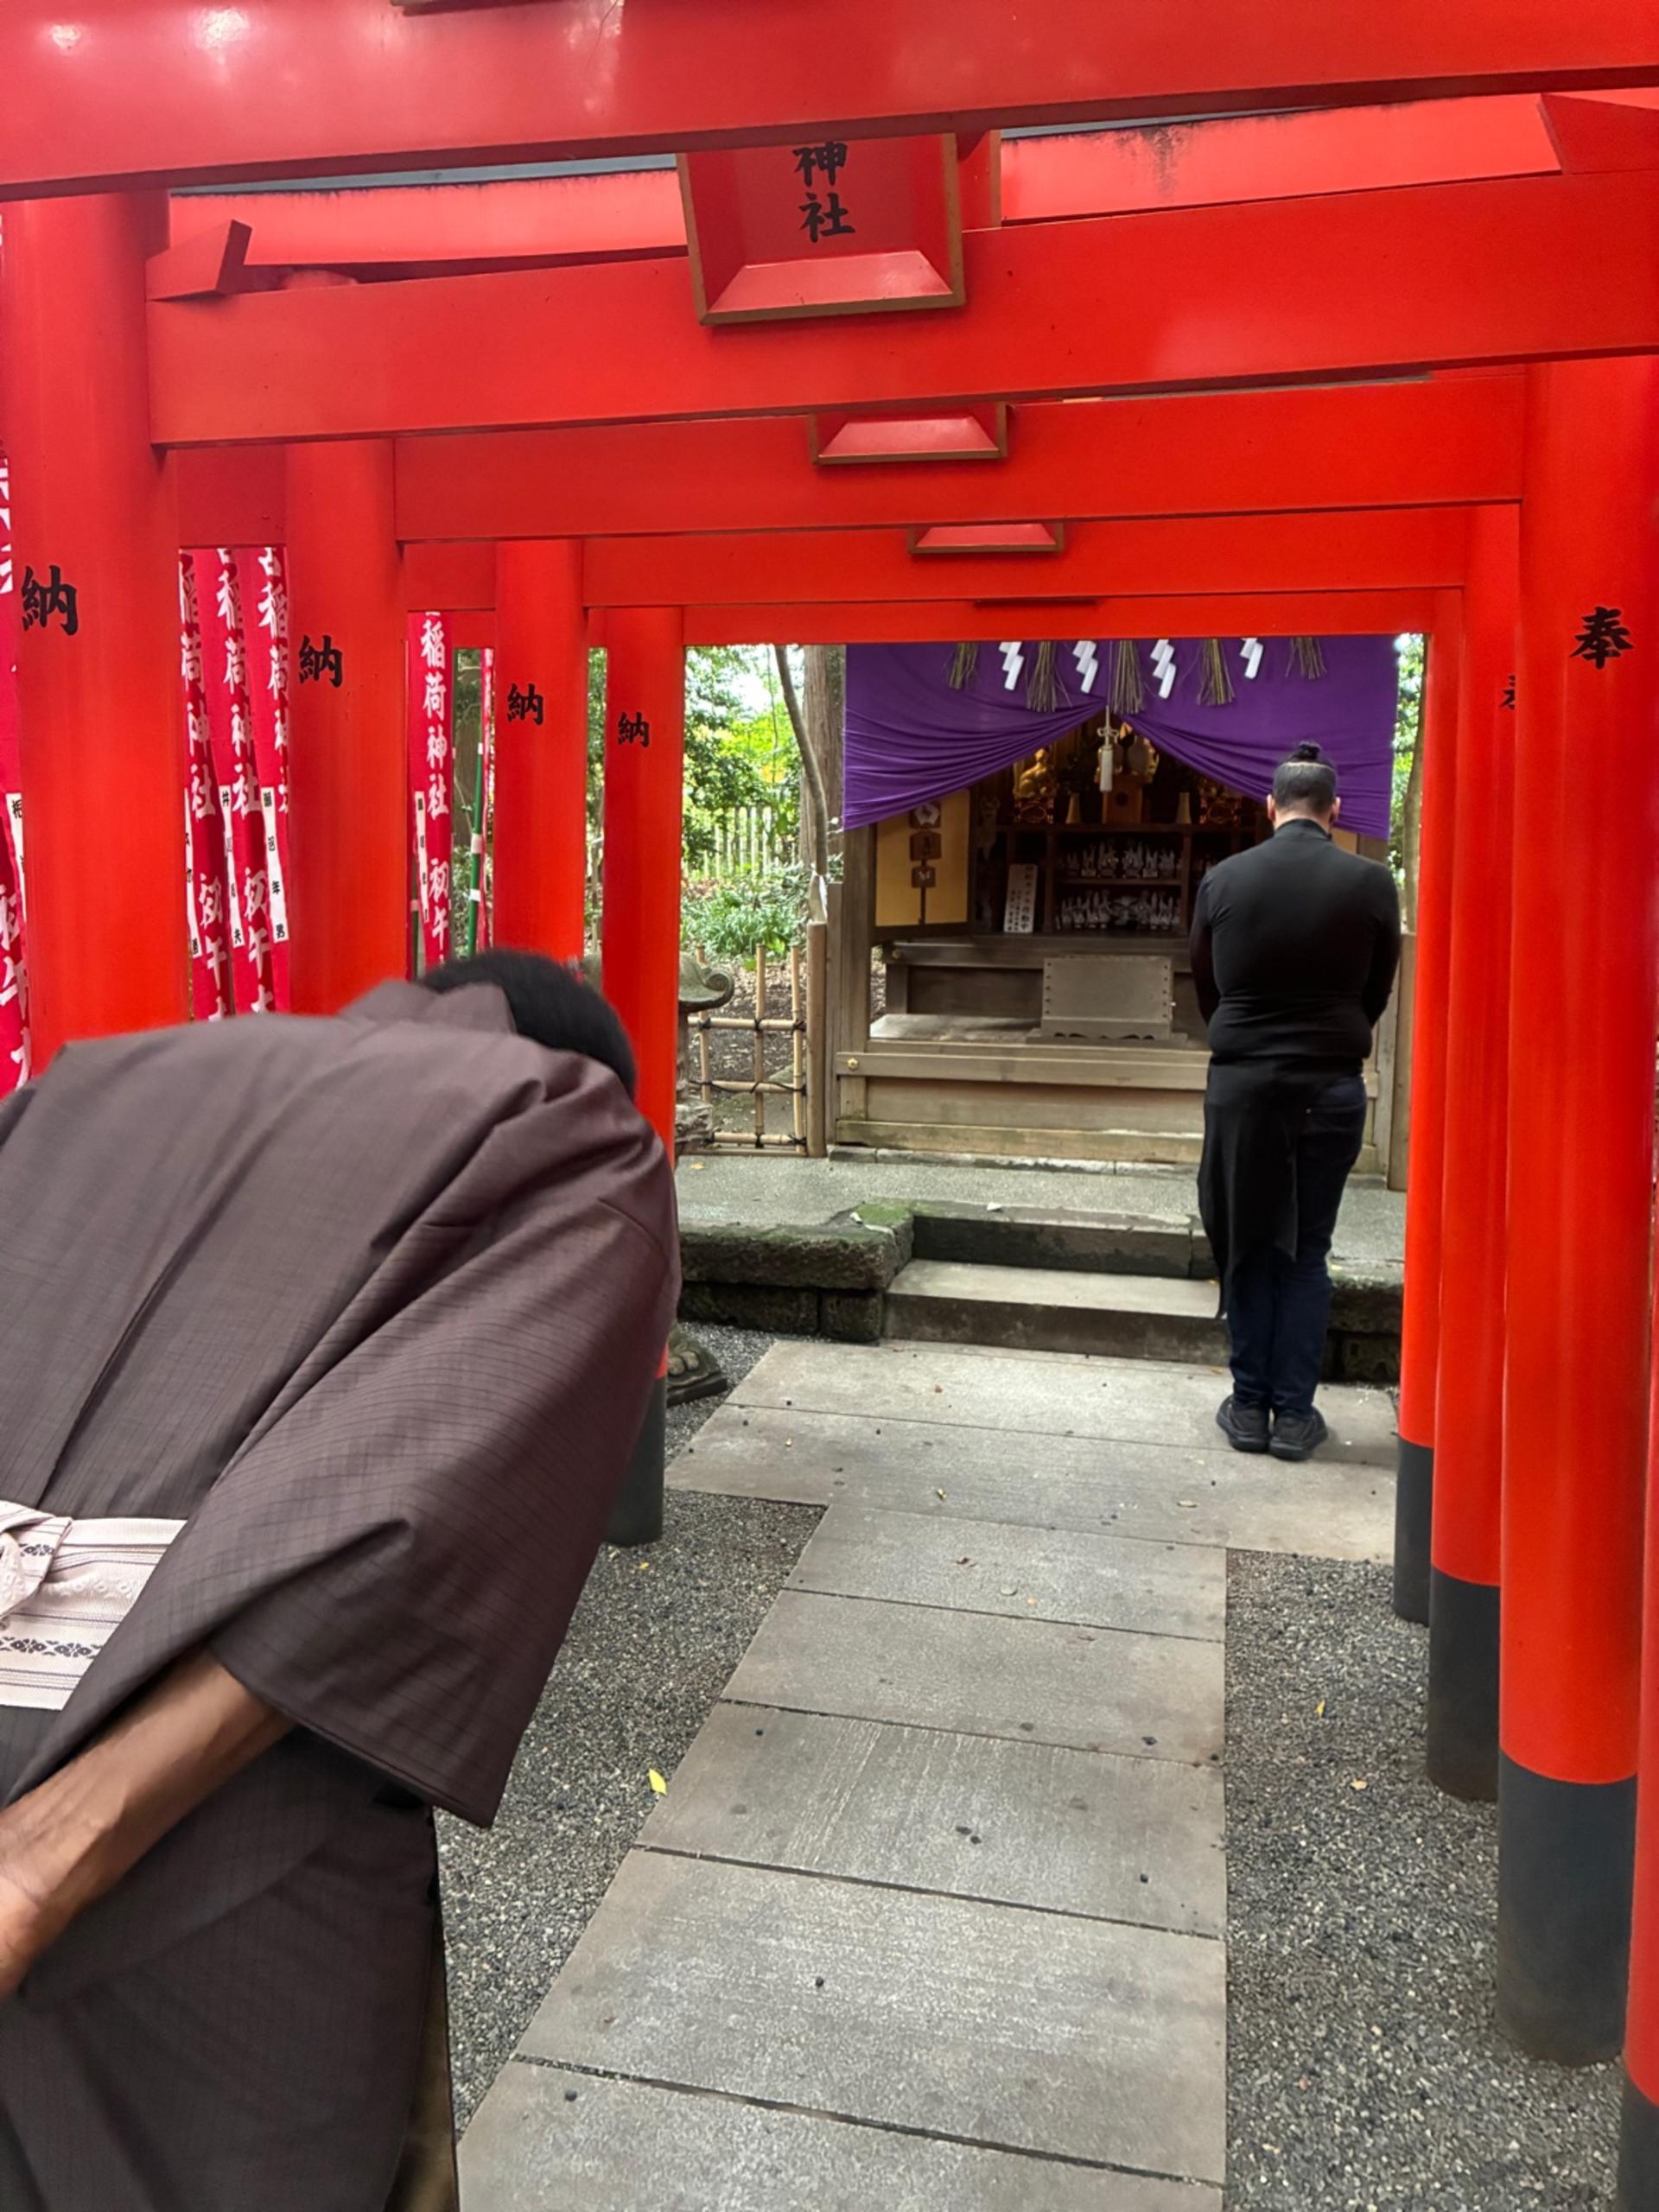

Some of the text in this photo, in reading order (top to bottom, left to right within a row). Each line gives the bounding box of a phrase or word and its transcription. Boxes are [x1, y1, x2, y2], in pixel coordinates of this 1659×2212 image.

[792, 141, 855, 243] 神社
[21, 564, 79, 637] 納
[298, 633, 343, 689] 納
[1568, 605, 1635, 671] 奉
[420, 611, 449, 820] 稲荷神社
[506, 683, 544, 726] 納
[617, 711, 651, 748] 納
